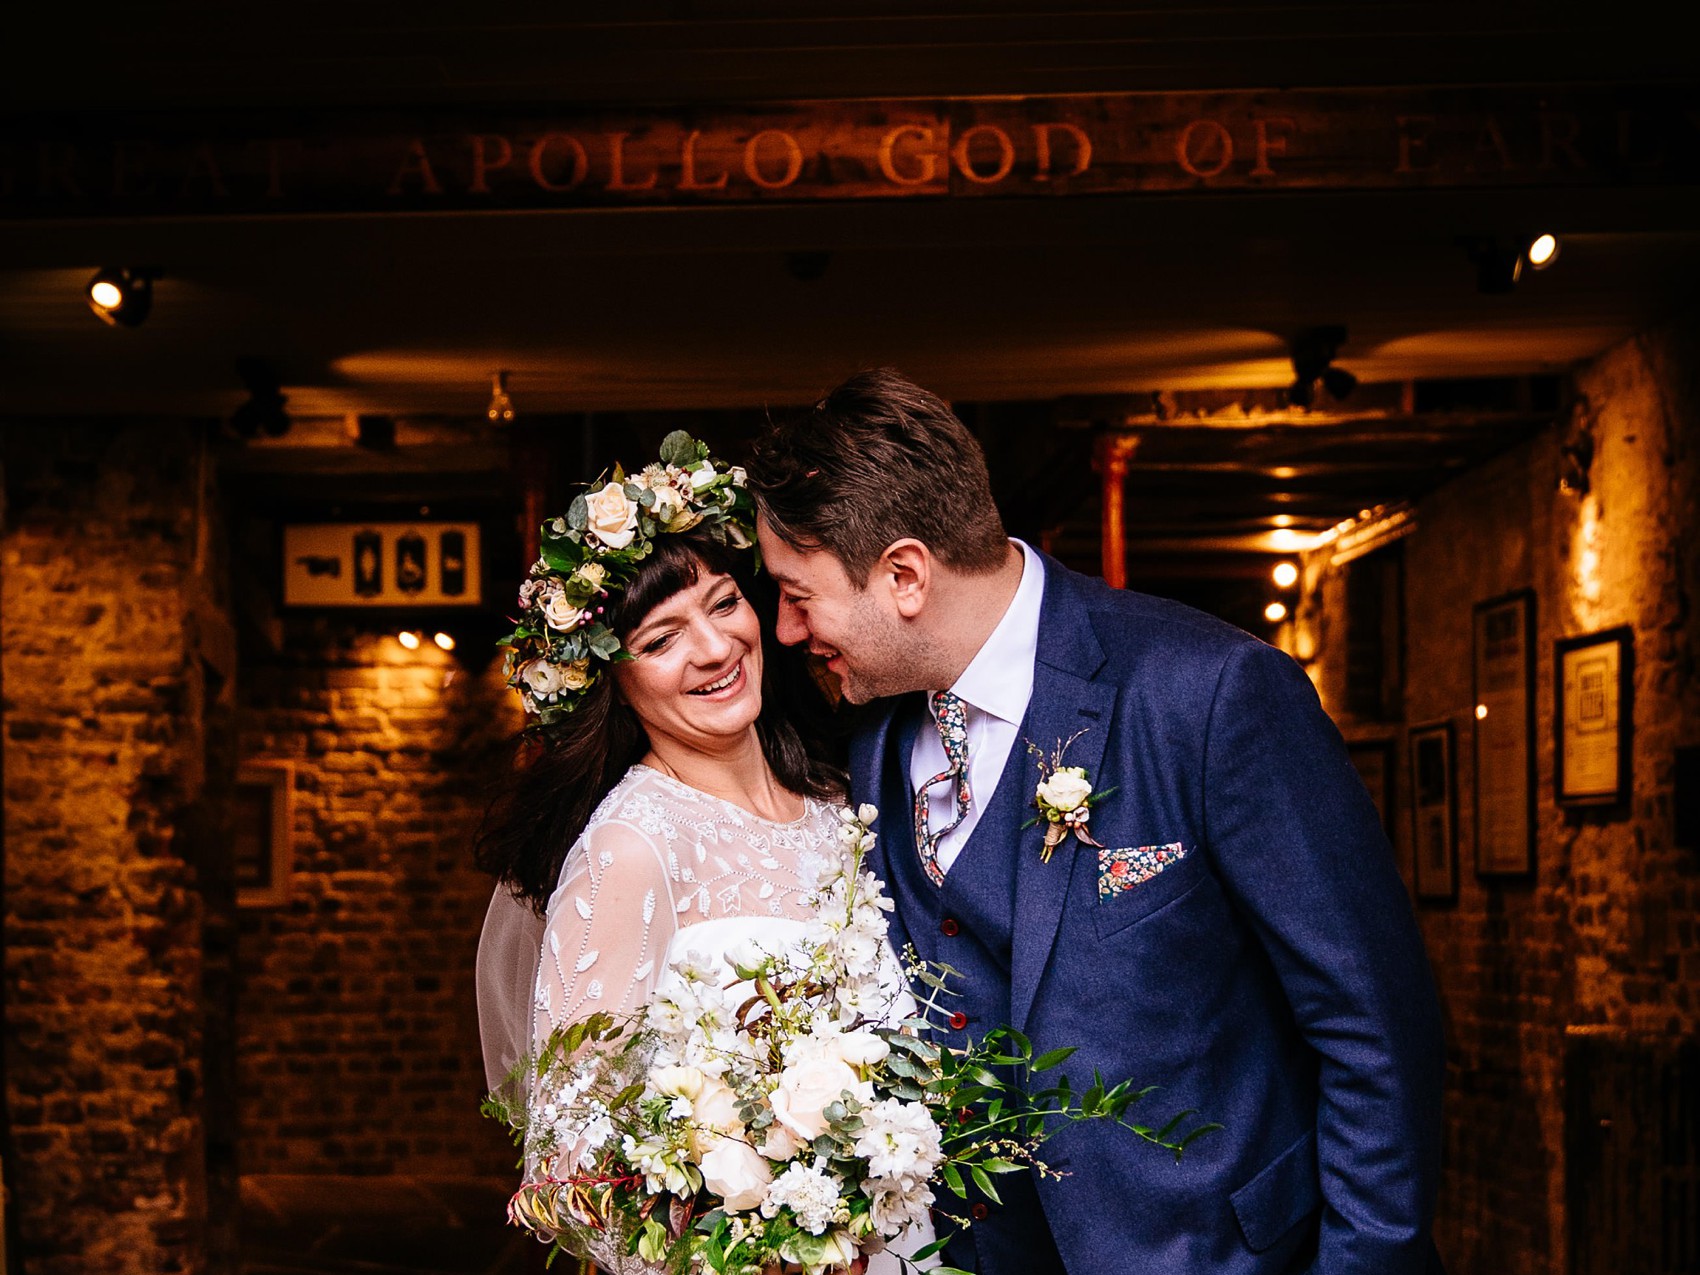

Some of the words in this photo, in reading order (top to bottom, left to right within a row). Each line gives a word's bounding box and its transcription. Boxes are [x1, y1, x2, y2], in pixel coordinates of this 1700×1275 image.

[386, 128, 804, 197] APOLLO
[878, 122, 1093, 186] GOD
[1175, 114, 1299, 179] OF
